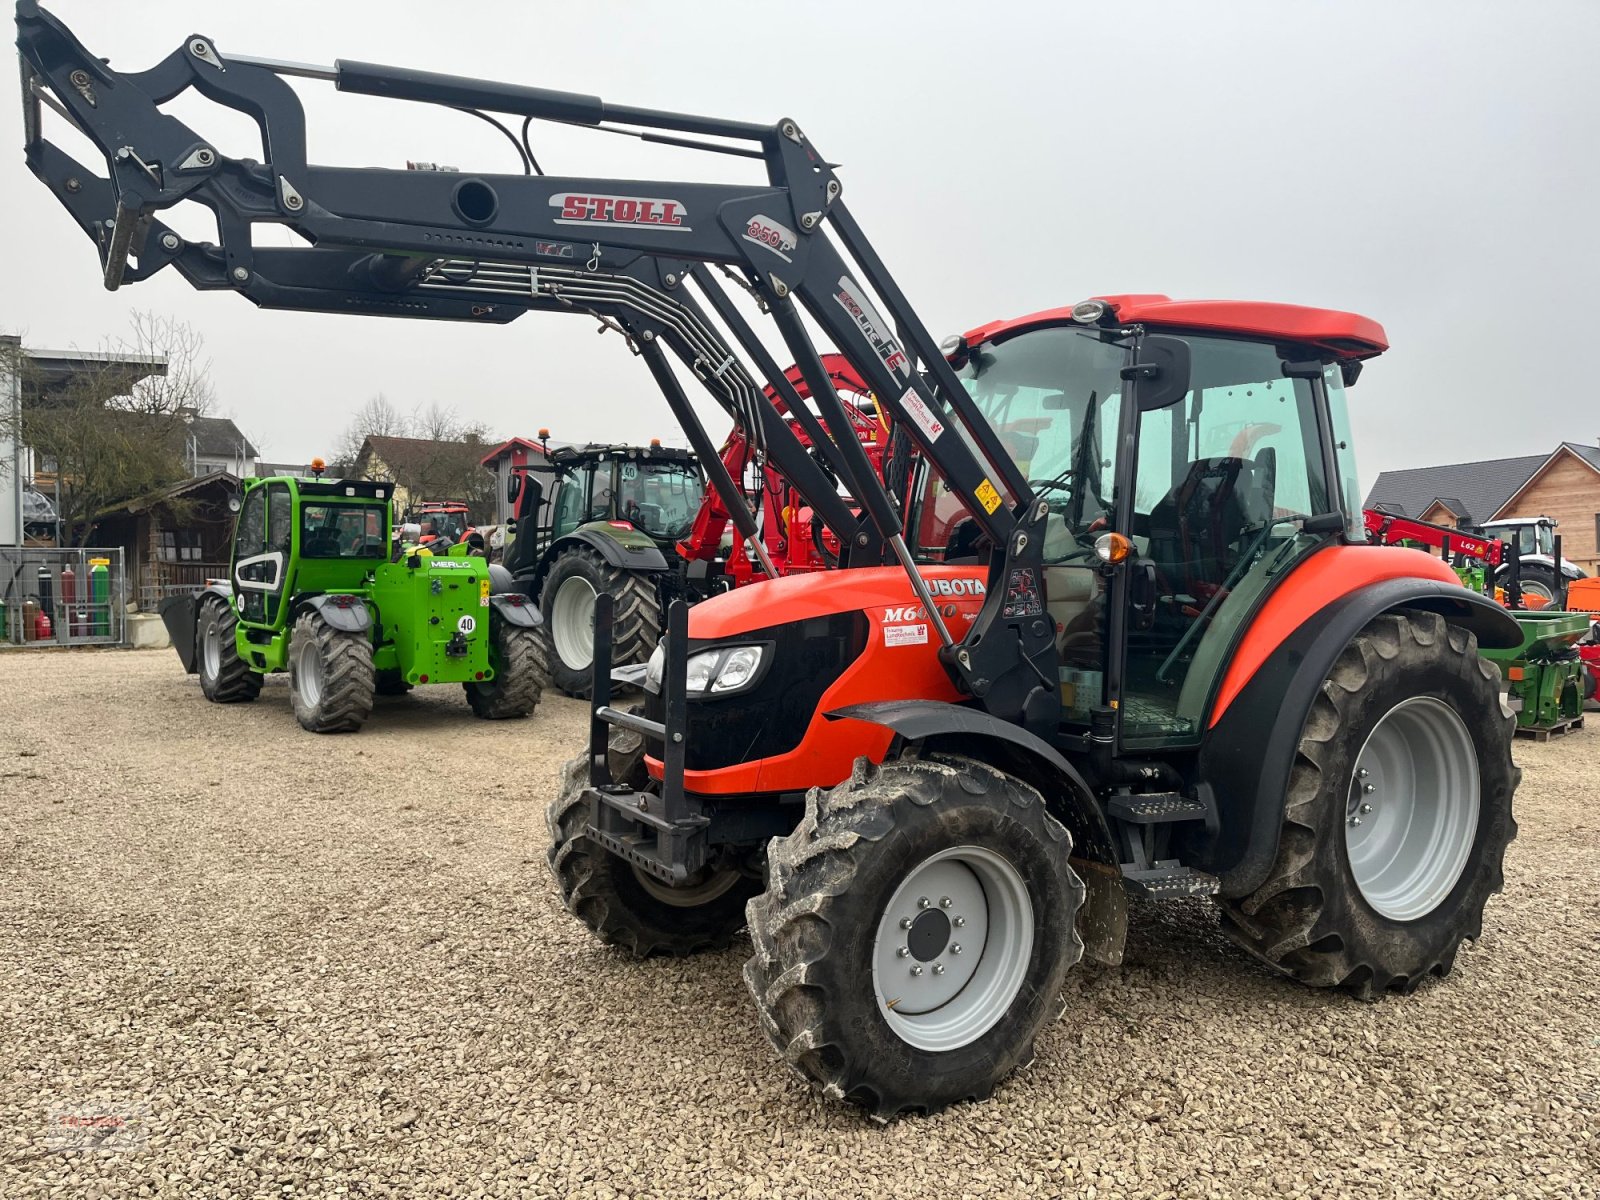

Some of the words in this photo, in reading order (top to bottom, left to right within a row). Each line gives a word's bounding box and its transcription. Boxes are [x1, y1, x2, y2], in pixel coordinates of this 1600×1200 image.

[561, 196, 681, 226] STOLL
[625, 466, 635, 478] 40
[1460, 541, 1475, 551] L62
[460, 618, 473, 631] 40
